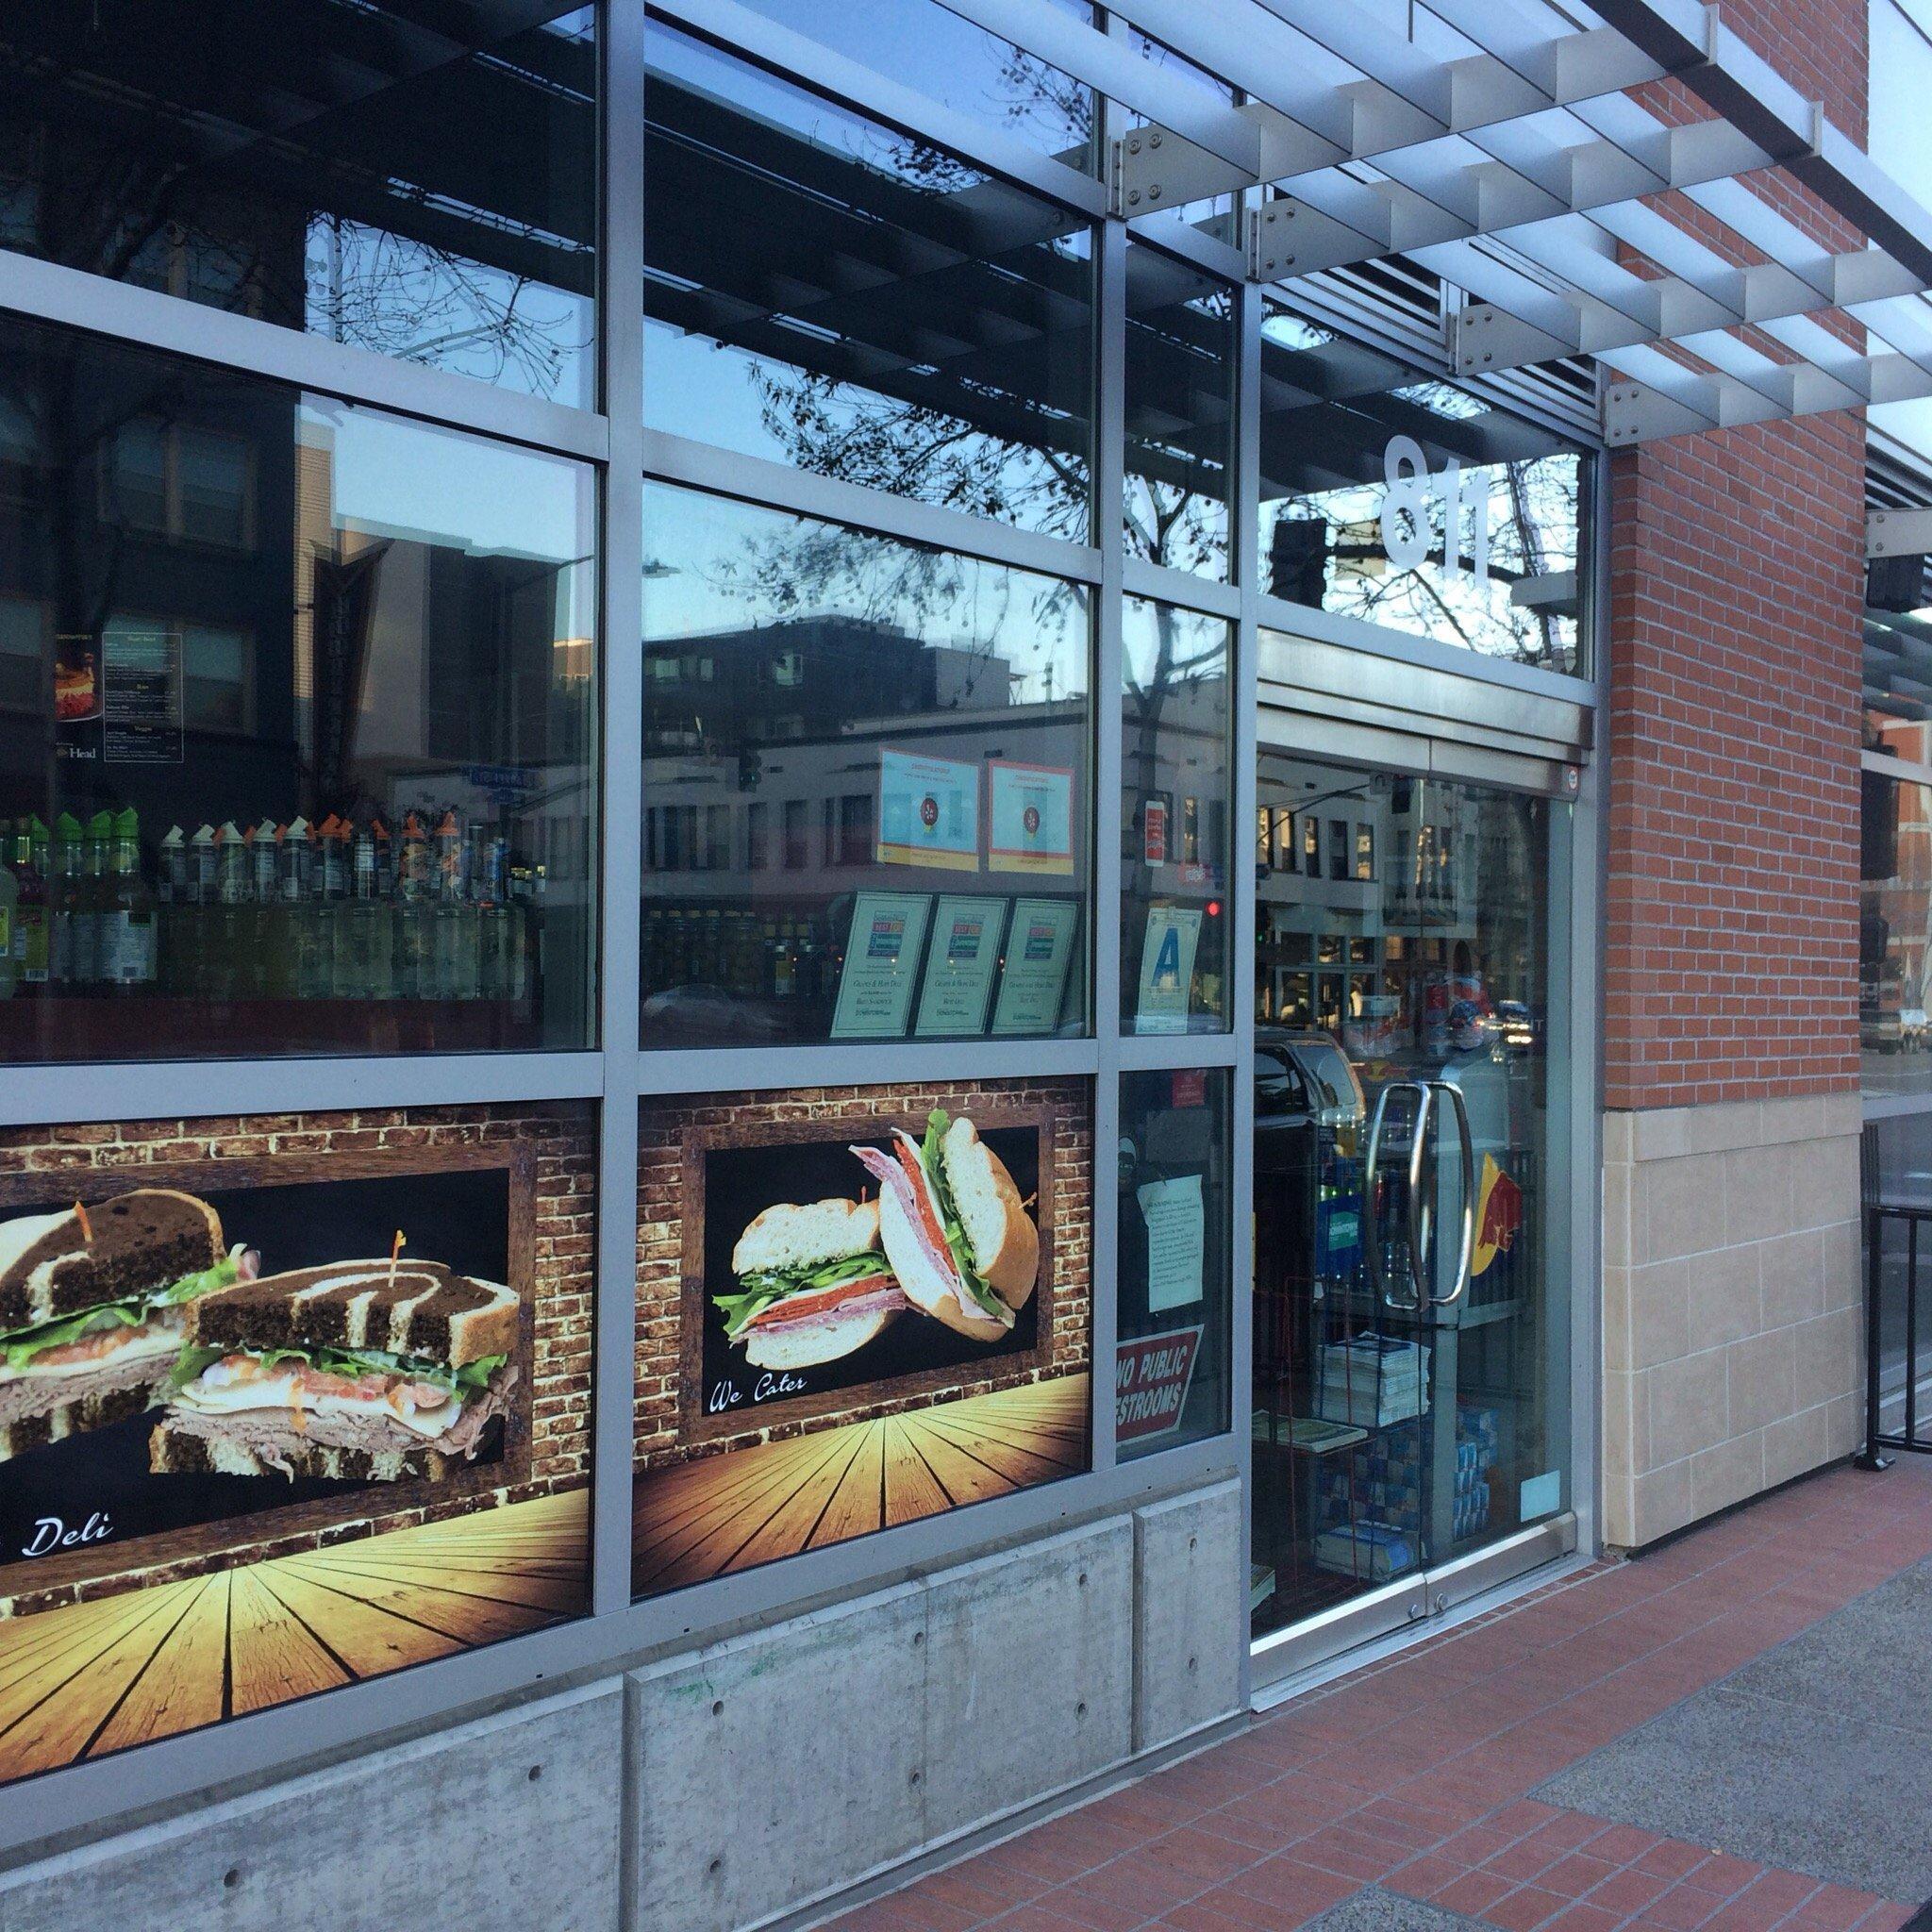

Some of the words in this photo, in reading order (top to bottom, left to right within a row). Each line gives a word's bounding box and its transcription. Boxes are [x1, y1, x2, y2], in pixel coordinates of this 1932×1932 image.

[1380, 435, 1489, 589] 811
[70, 747, 96, 758] Head
[1151, 927, 1180, 988] A
[1139, 1345, 1188, 1383] PUBLIC
[709, 1380, 743, 1412] We
[754, 1373, 808, 1402] Cater
[1117, 1383, 1182, 1425] ESTROOMS
[22, 1511, 114, 1557] Deli
